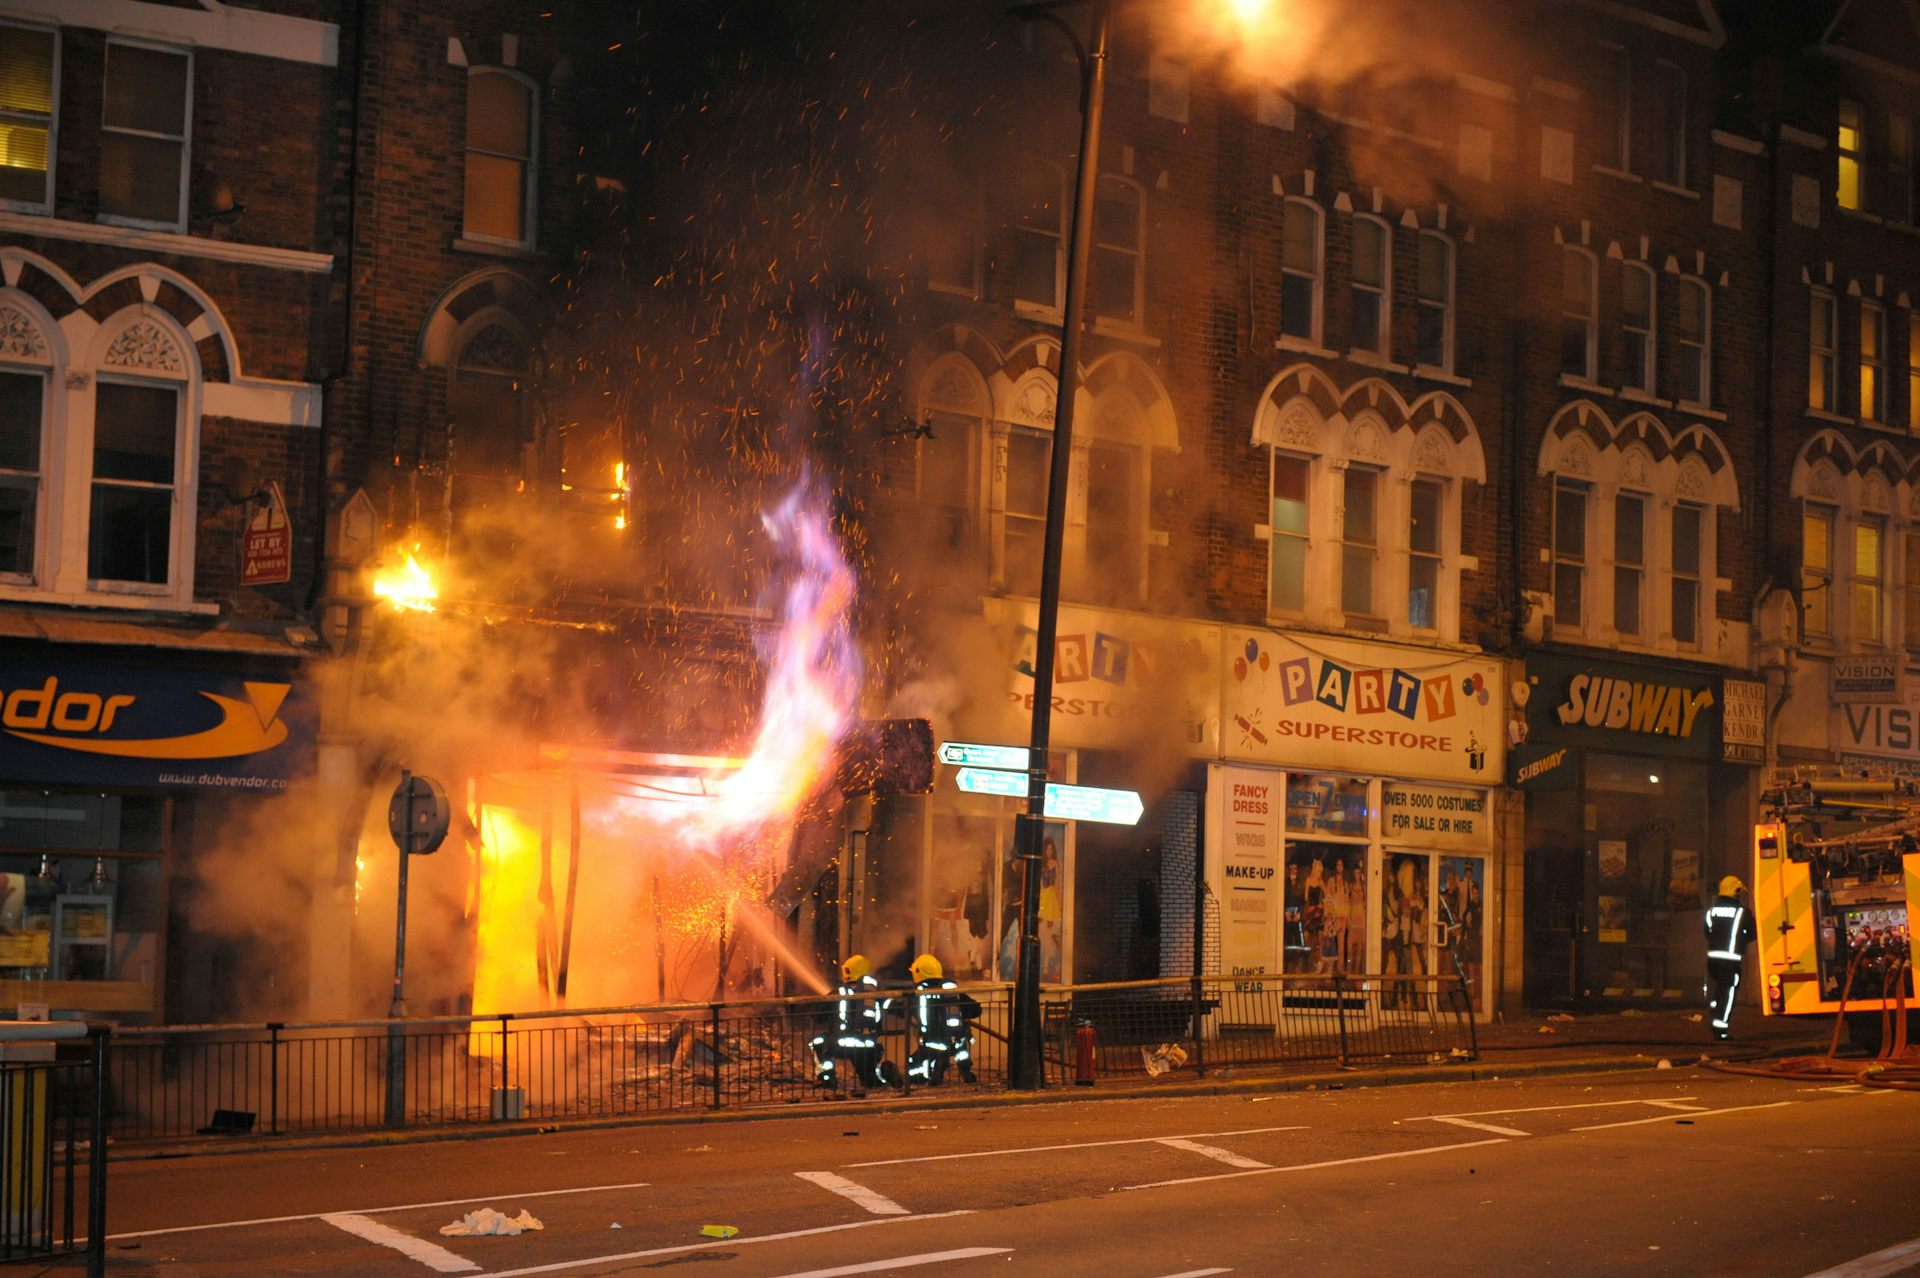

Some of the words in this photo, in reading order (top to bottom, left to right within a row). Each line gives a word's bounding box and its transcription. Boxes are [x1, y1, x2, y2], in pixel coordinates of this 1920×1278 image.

[250, 538, 266, 550] LET
[269, 537, 281, 549] BY
[1013, 632, 1160, 680] ARTY
[1837, 666, 1895, 678] VISION
[1282, 661, 1452, 718] PARTY
[1725, 680, 1764, 700] MICHAEL
[0, 675, 136, 732] dor
[1556, 673, 1714, 737] SUBWAY
[1724, 701, 1764, 720] GARNET
[1276, 719, 1452, 752] SUPERSTORE
[1724, 721, 1765, 742] KENDRA
[1516, 748, 1567, 784] SUBWAY
[1233, 784, 1268, 799] FANCY
[1318, 781, 1334, 815] 7
[1384, 790, 1407, 806] OVER
[1410, 793, 1434, 808] 5000
[1437, 795, 1482, 813] COSTUMES
[1233, 799, 1268, 815] DRESS
[1392, 814, 1410, 829] FOR
[1414, 816, 1435, 831] SALE
[1438, 817, 1450, 832] OR
[1453, 819, 1473, 834] HIRE
[1235, 832, 1266, 848] WIGS
[1226, 865, 1274, 879] MAKE-UP
[1234, 981, 1263, 994] WEAR
